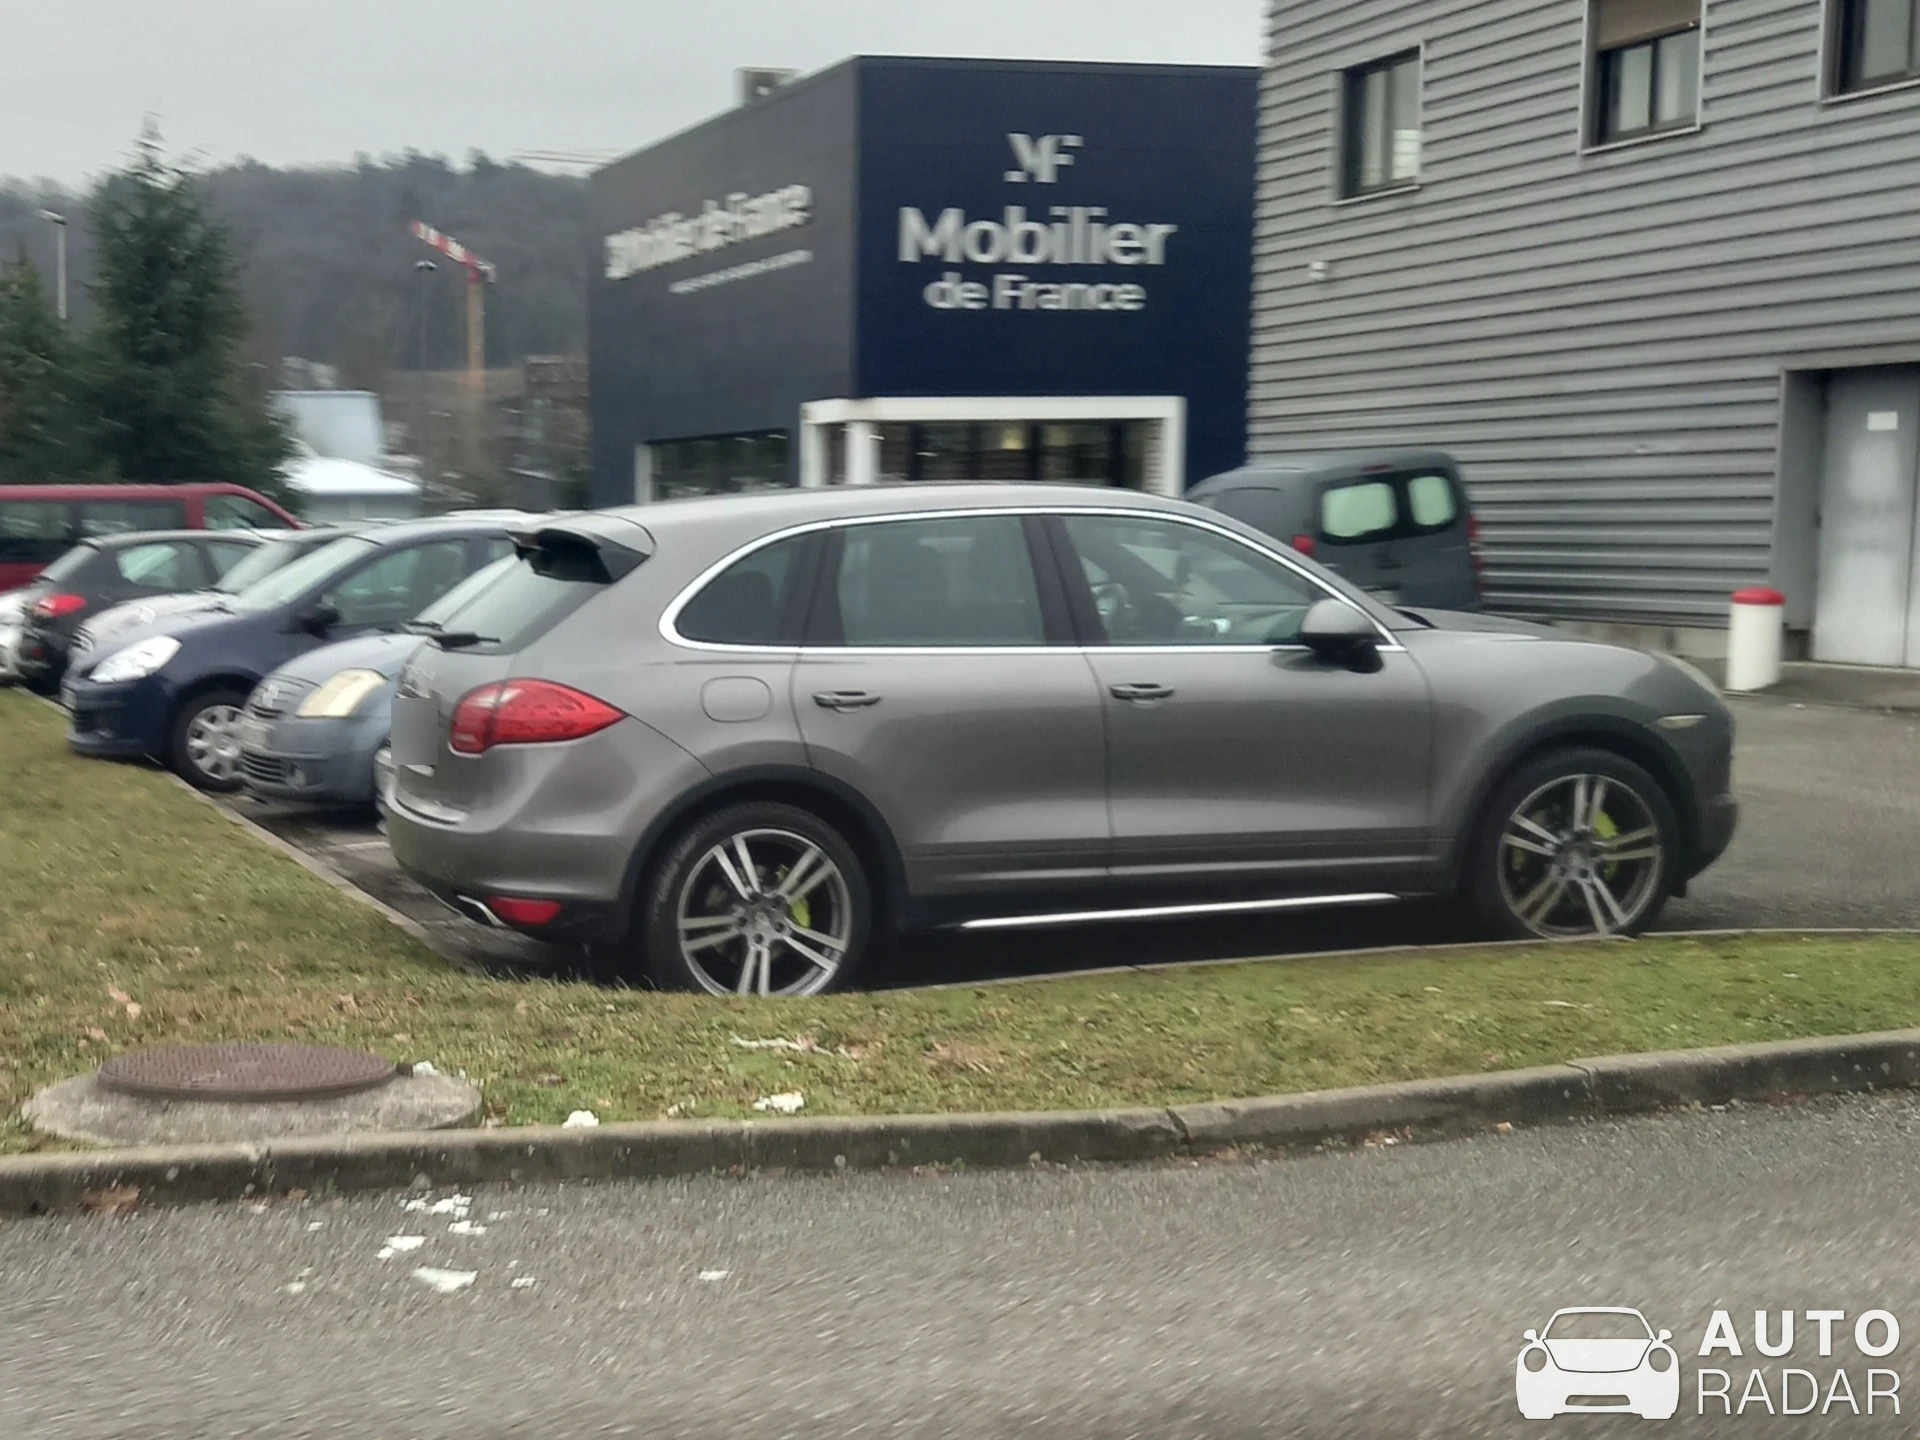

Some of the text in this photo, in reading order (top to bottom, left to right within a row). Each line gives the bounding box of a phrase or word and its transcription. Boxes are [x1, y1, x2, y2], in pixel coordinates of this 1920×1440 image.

[898, 206, 1178, 265] Mobilier
[922, 272, 1146, 311] de France
